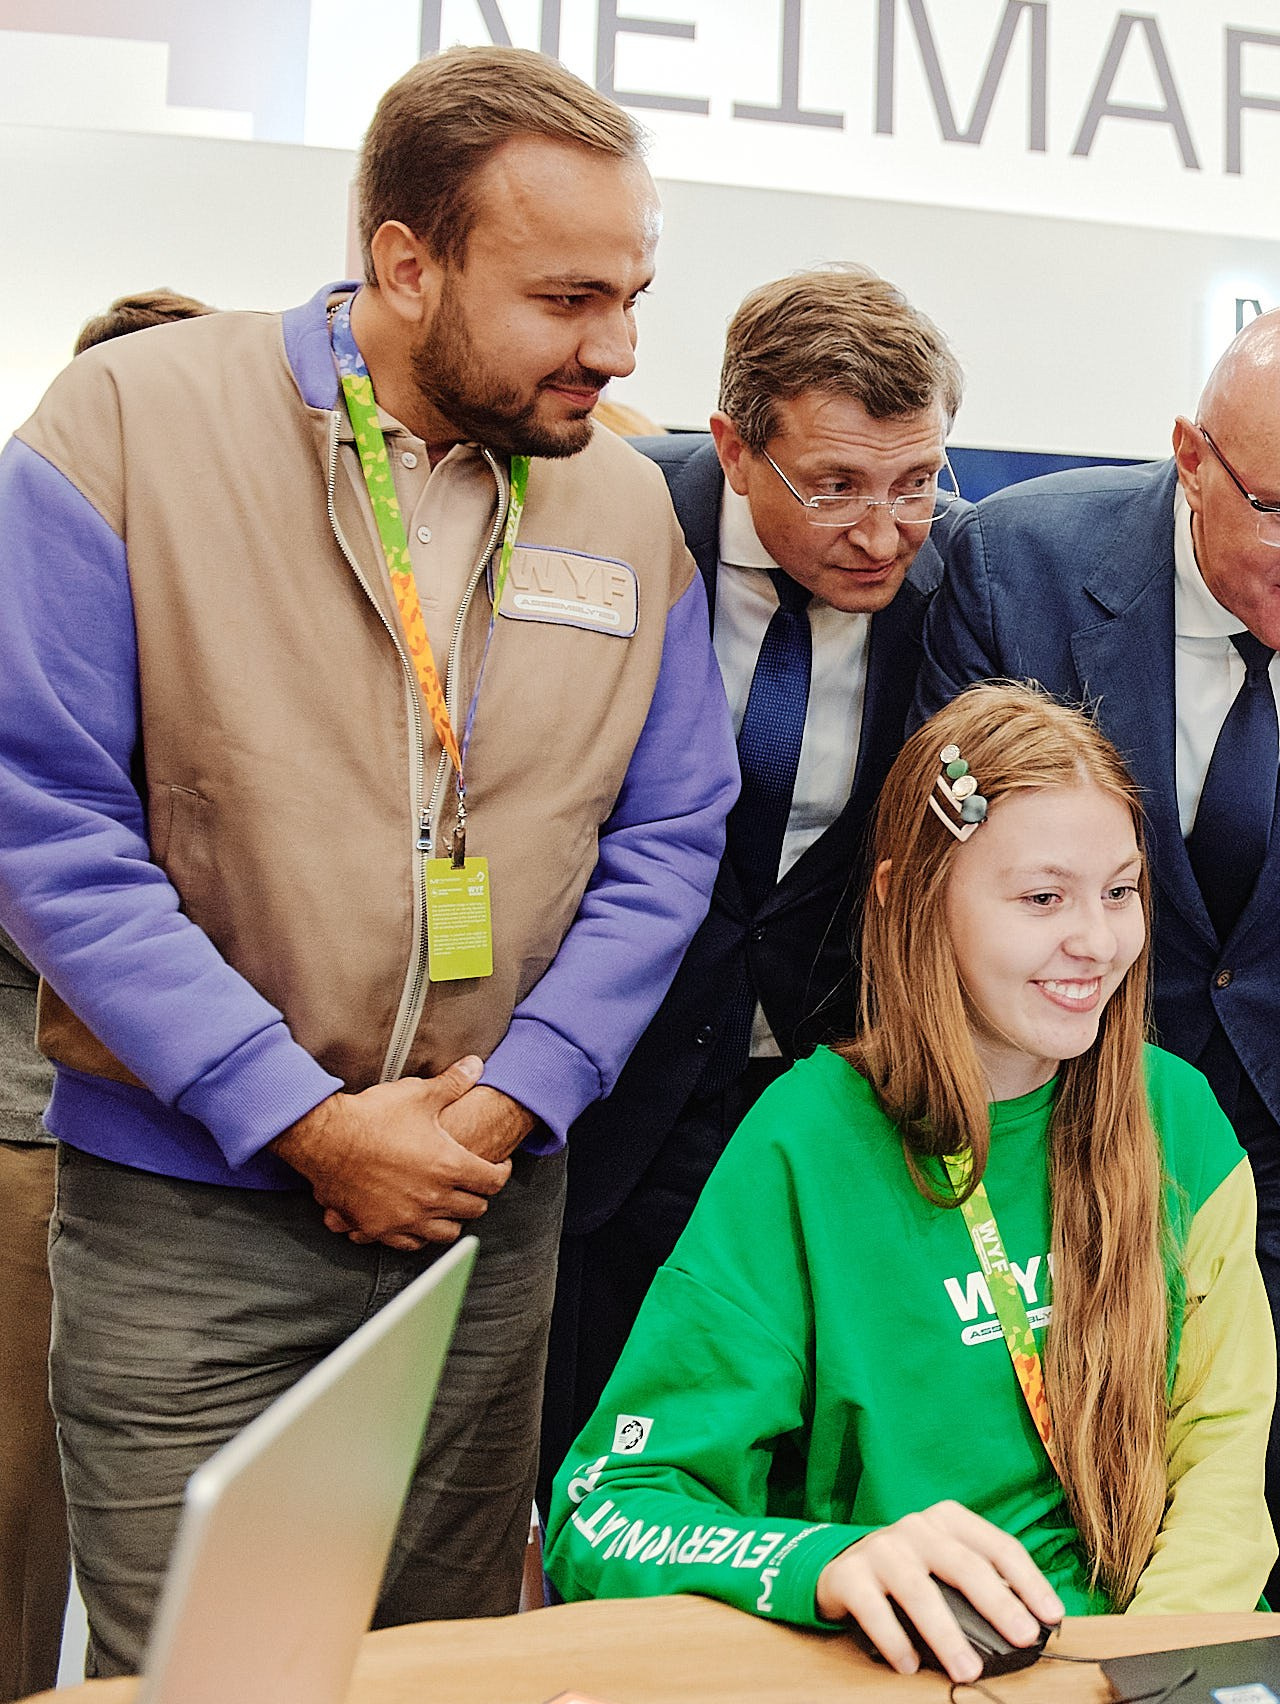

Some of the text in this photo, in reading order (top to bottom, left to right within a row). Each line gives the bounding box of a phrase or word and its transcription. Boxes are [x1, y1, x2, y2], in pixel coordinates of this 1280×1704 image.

[510, 551, 627, 606] WYF
[978, 1218, 1009, 1273] WYF
[969, 1310, 1053, 1340] ASSBLY
